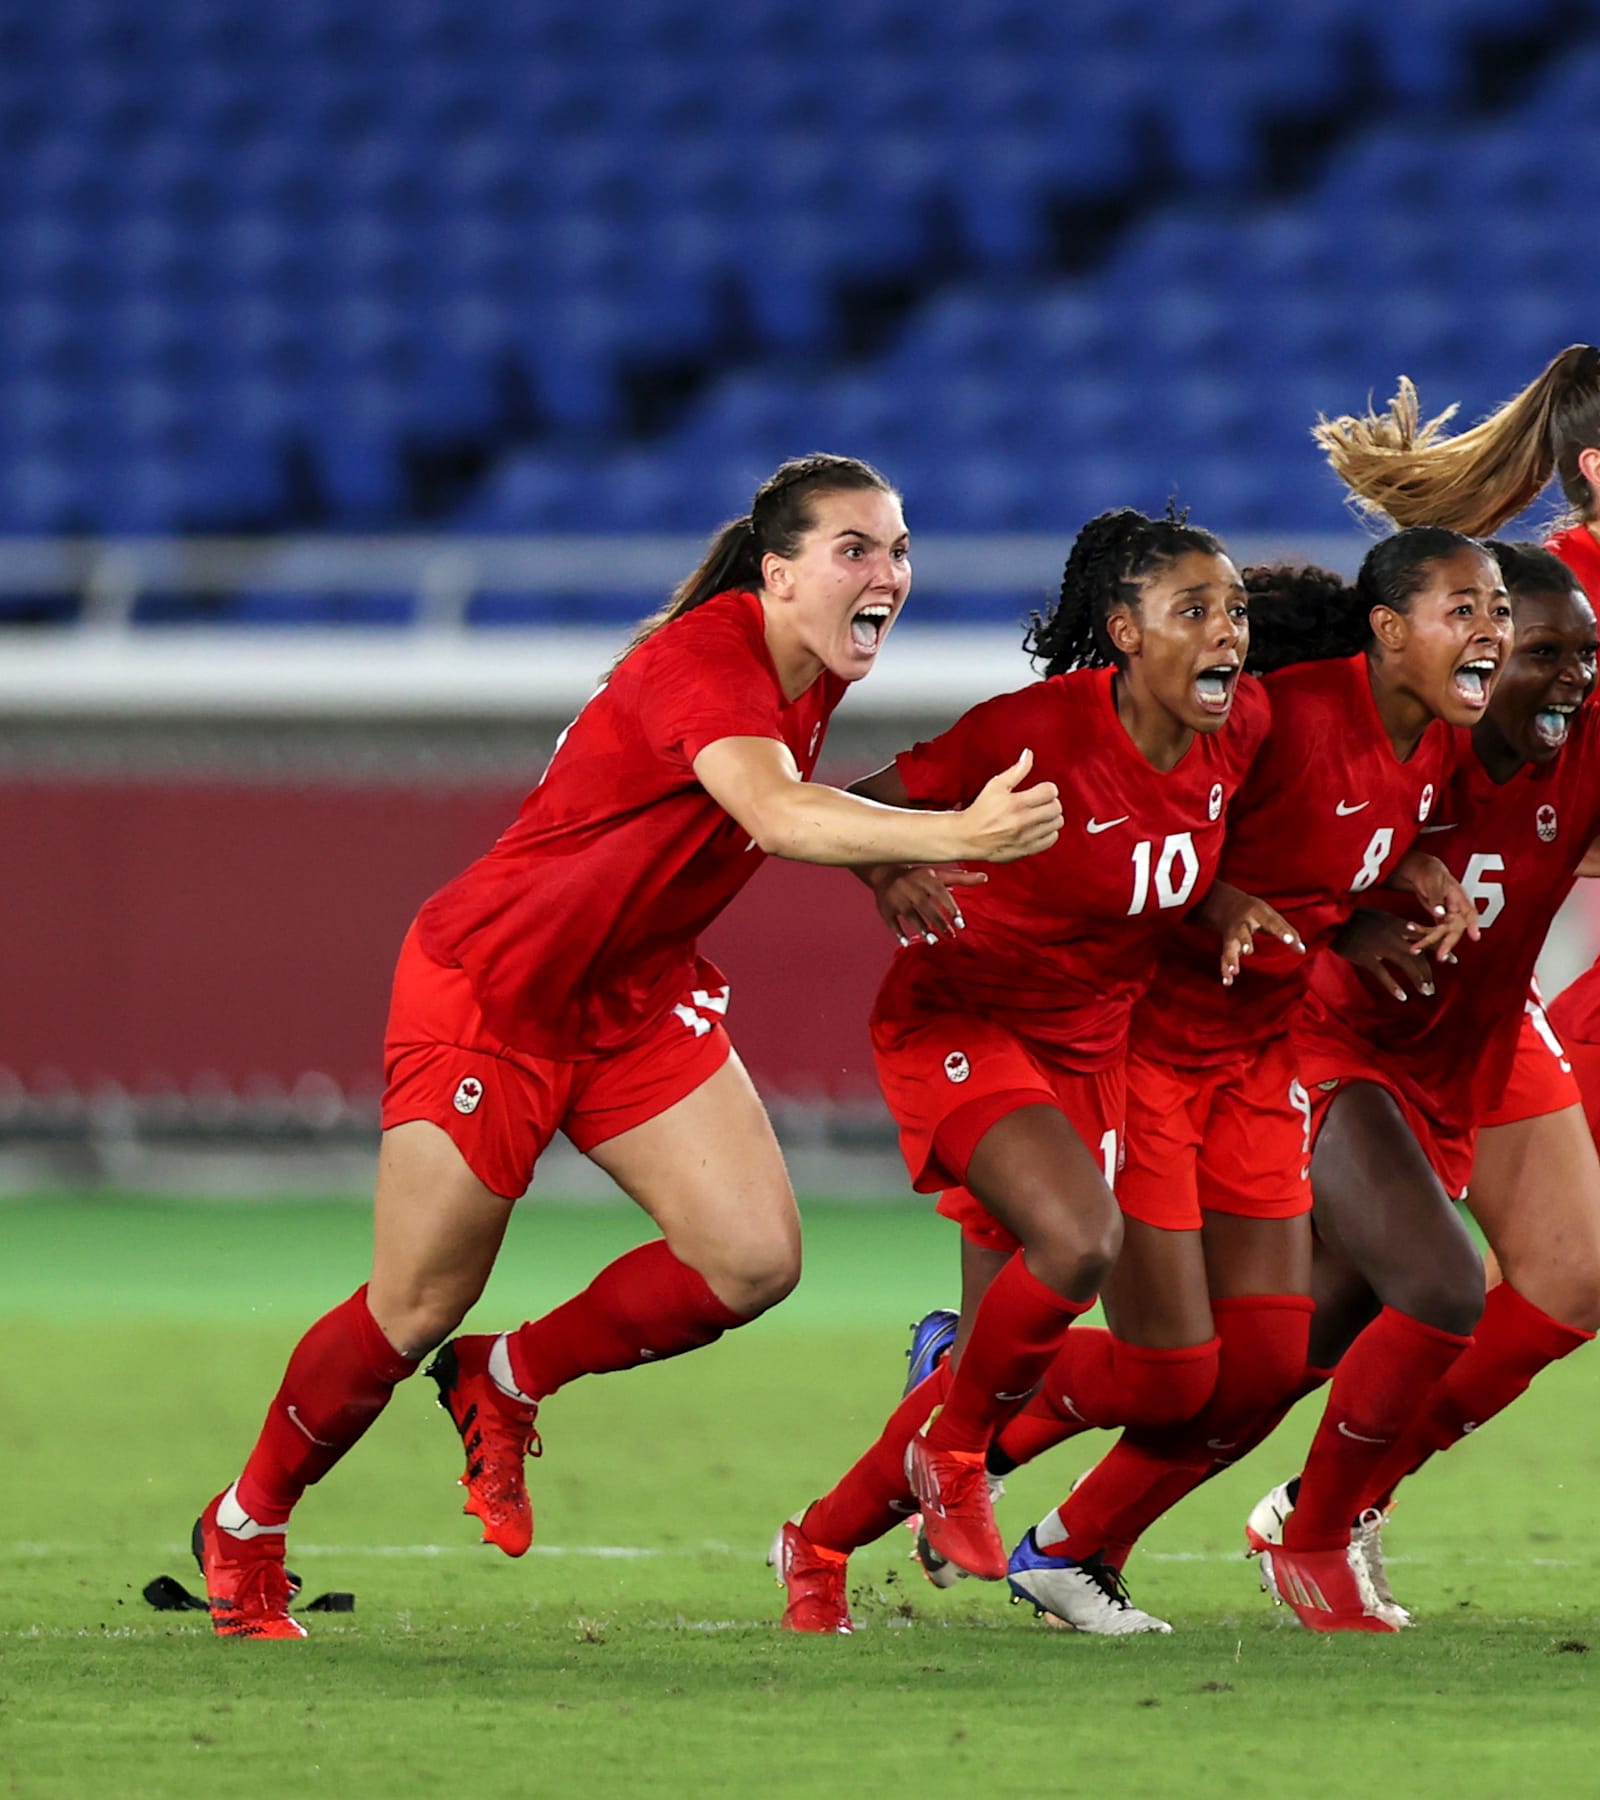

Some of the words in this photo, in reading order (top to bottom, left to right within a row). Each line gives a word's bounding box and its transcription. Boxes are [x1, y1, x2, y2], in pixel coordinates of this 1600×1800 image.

[1127, 831, 1200, 916] 10
[1349, 827, 1394, 892] 8
[1460, 853, 1505, 928] 6
